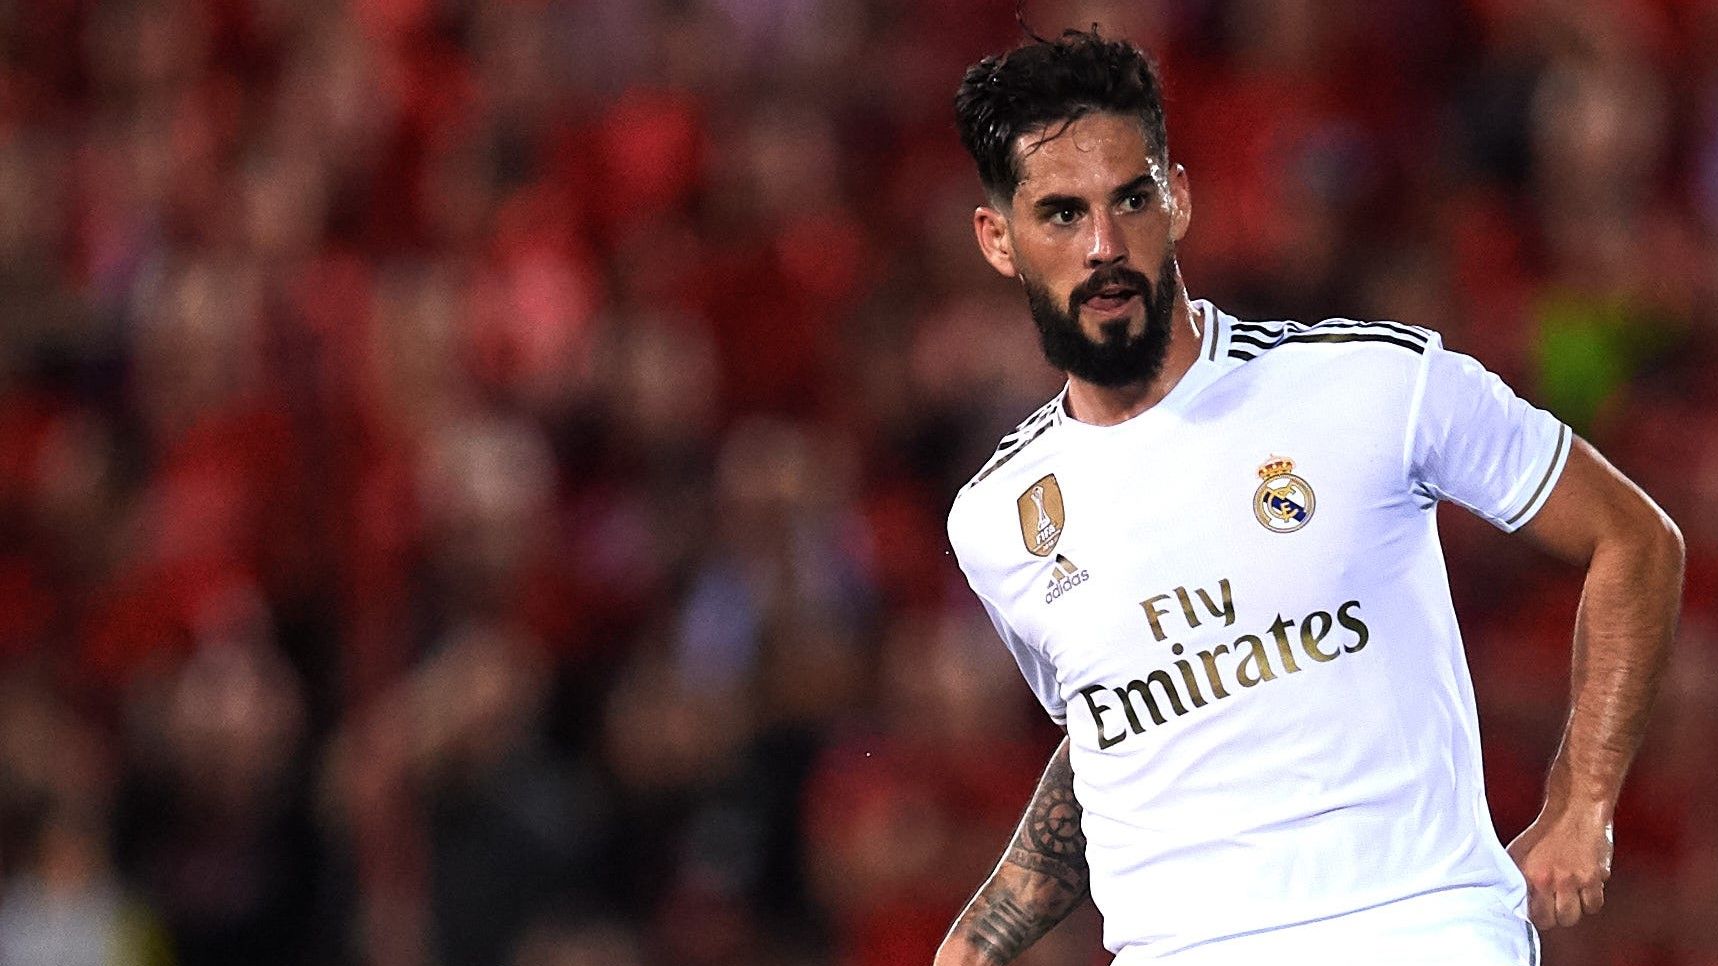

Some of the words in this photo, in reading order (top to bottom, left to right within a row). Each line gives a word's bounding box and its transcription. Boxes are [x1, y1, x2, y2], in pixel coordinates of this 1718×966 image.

[1045, 569, 1090, 605] adidas
[1139, 577, 1235, 642] Fly
[1080, 598, 1370, 750] Emirates
